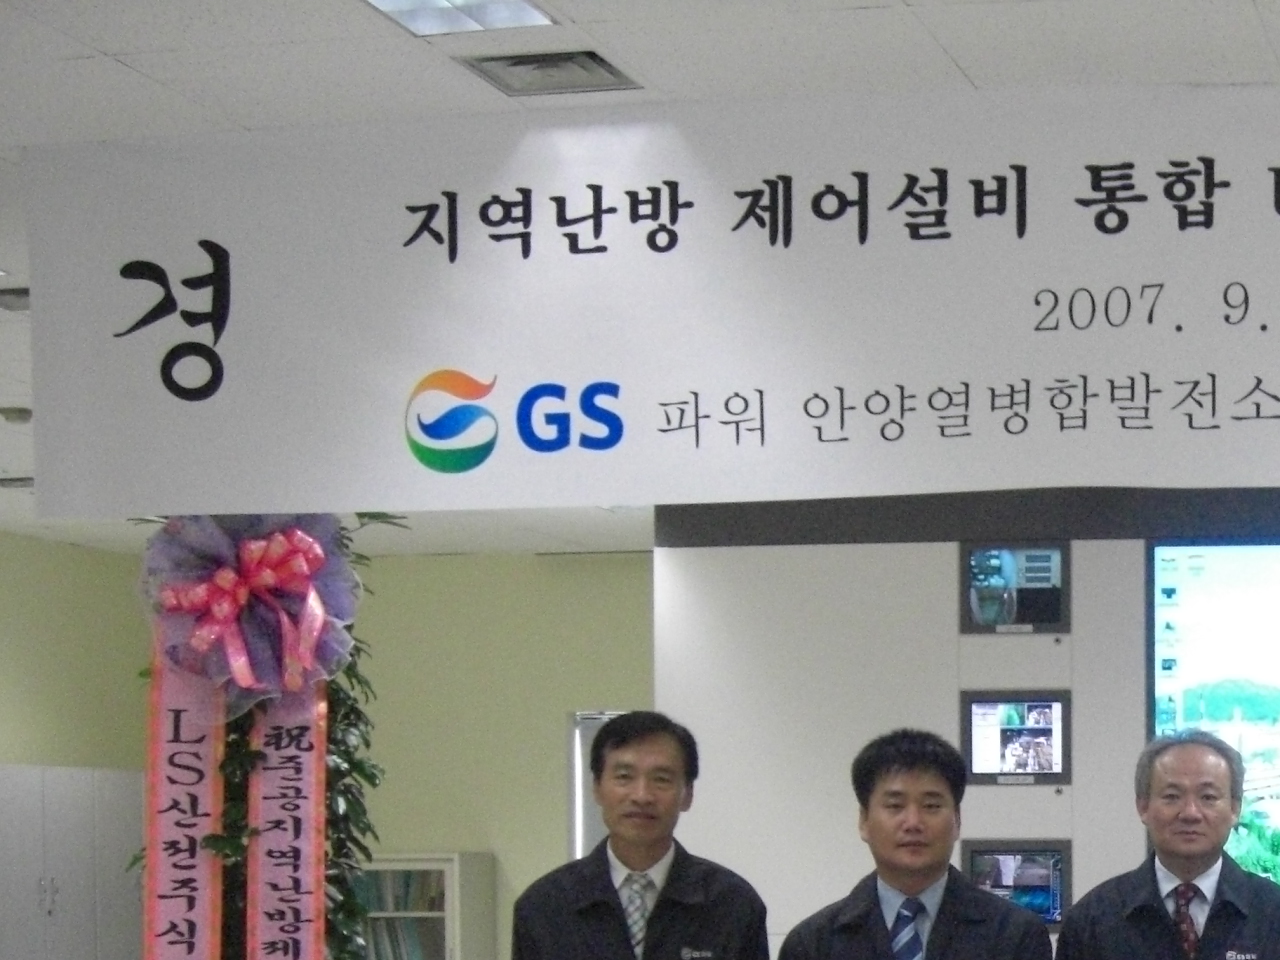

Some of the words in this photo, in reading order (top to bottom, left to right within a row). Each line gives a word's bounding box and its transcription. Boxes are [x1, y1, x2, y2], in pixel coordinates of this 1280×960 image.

[402, 179, 695, 264] 지역난방
[732, 164, 1029, 249] 제어설비
[1074, 156, 1231, 235] 통합
[113, 239, 231, 402] 경
[1033, 283, 1184, 333] 2007.
[1222, 281, 1269, 332] 9.
[516, 382, 625, 453] GS
[657, 388, 767, 448] 파워
